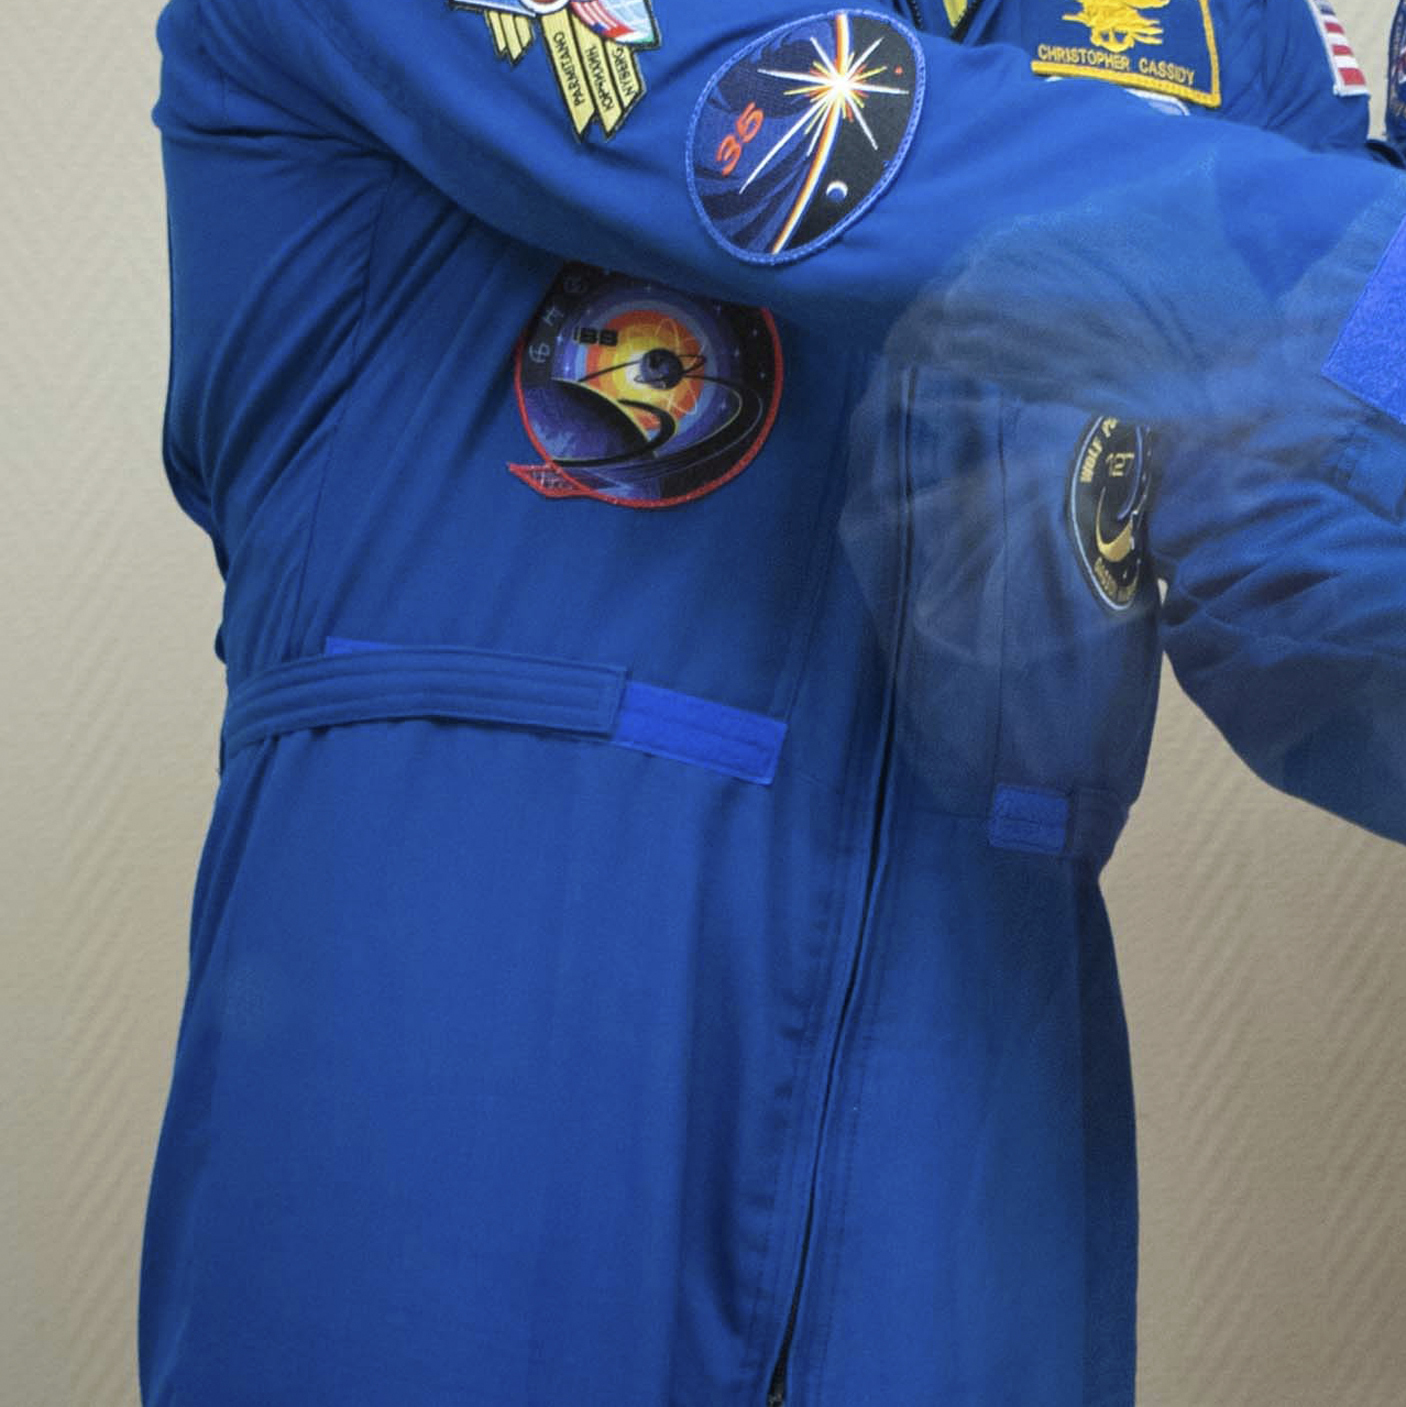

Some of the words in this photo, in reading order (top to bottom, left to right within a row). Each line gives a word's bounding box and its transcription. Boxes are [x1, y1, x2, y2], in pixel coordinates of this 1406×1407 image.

[553, 31, 585, 108] PARMITANO
[611, 47, 635, 98] NYBERG
[1037, 44, 1130, 71] CHRISTOPHER
[1138, 57, 1196, 86] CASSIDY
